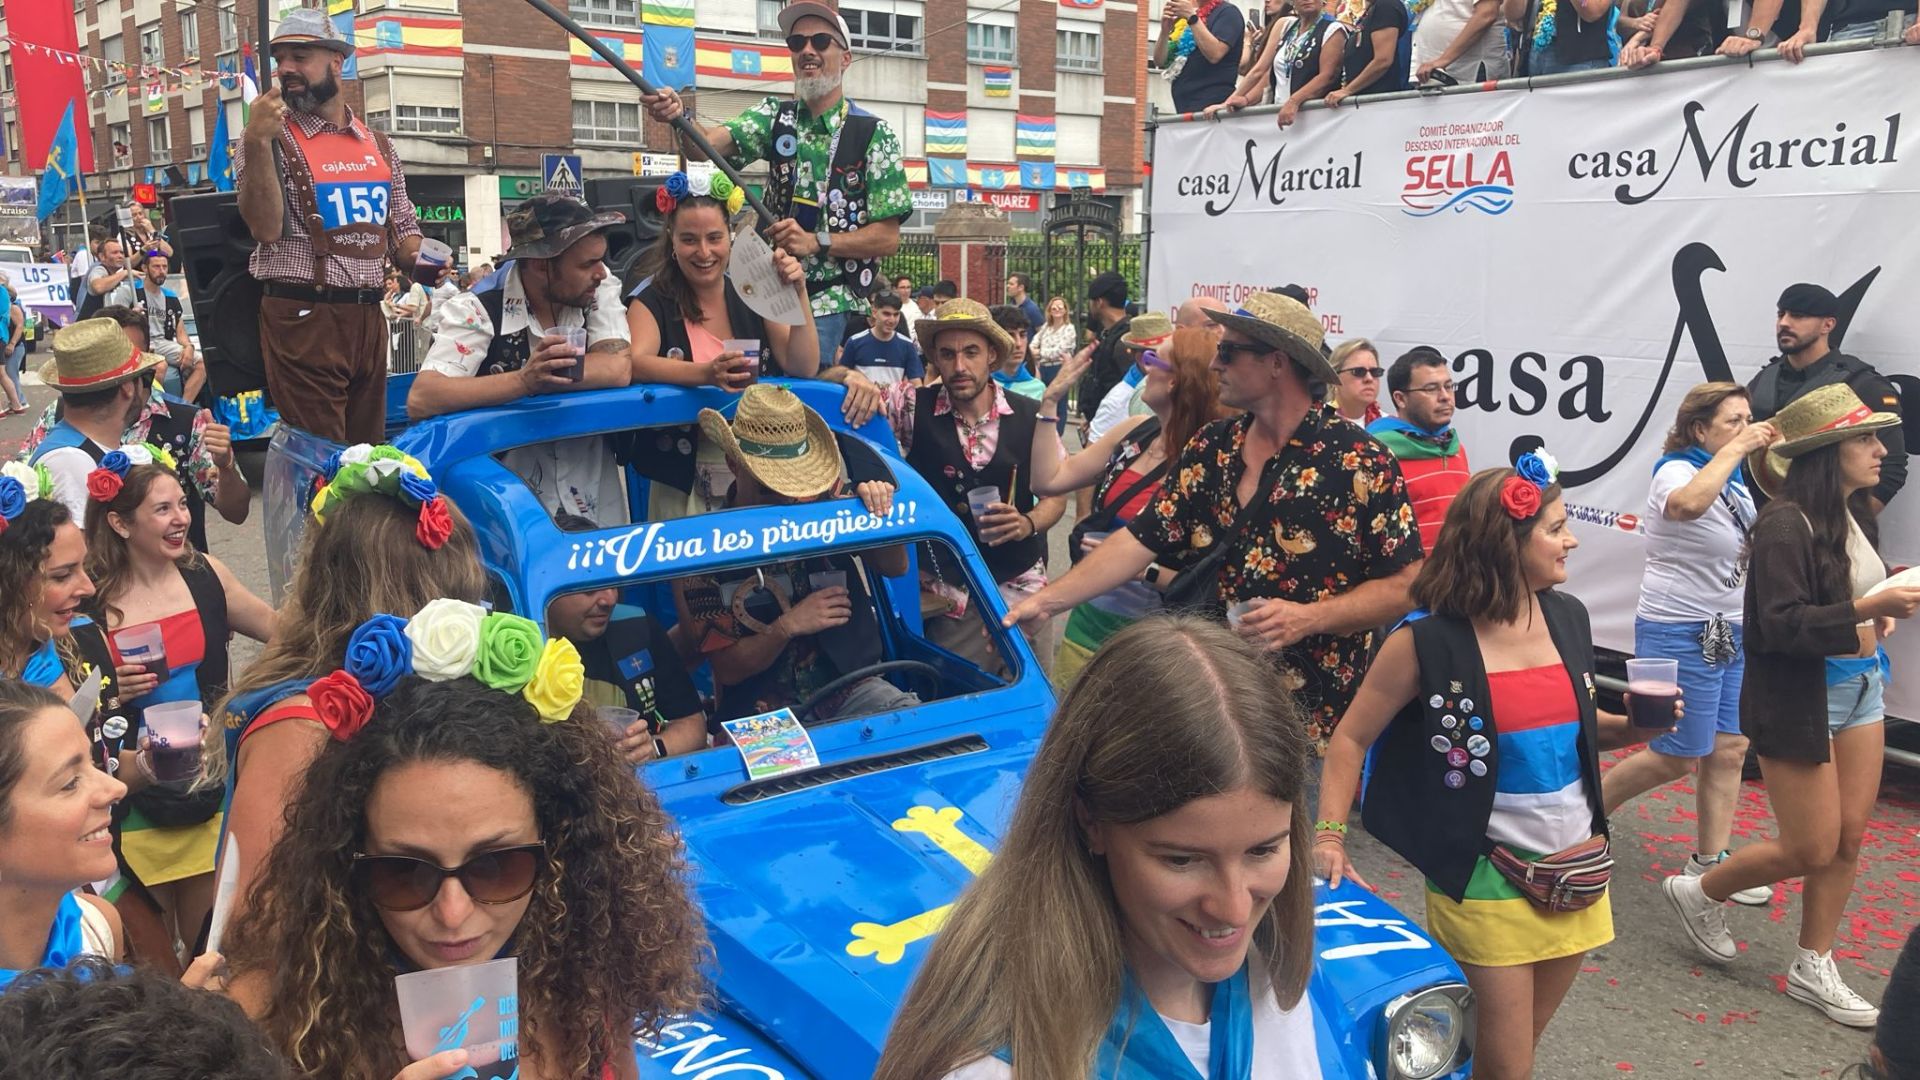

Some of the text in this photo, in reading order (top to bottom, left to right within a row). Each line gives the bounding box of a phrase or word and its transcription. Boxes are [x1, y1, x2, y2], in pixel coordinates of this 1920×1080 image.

[1420, 121, 1504, 138] COMITÉ ORGANIZADOR
[1405, 134, 1520, 152] DESCENSO INTERNACIONAL DEL
[1568, 101, 1901, 205] casa Marcial
[322, 161, 367, 174] cajAstur
[1404, 151, 1514, 190] SELLA
[516, 179, 541, 195] OP
[1178, 139, 1363, 216] casa Marcial
[328, 186, 388, 226] 153
[415, 205, 464, 221] MACIA
[912, 200, 945, 208] chones
[22, 267, 50, 283] LOS
[1322, 314, 1344, 334] DEL
[1452, 348, 1612, 422] asa
[712, 528, 754, 553] les
